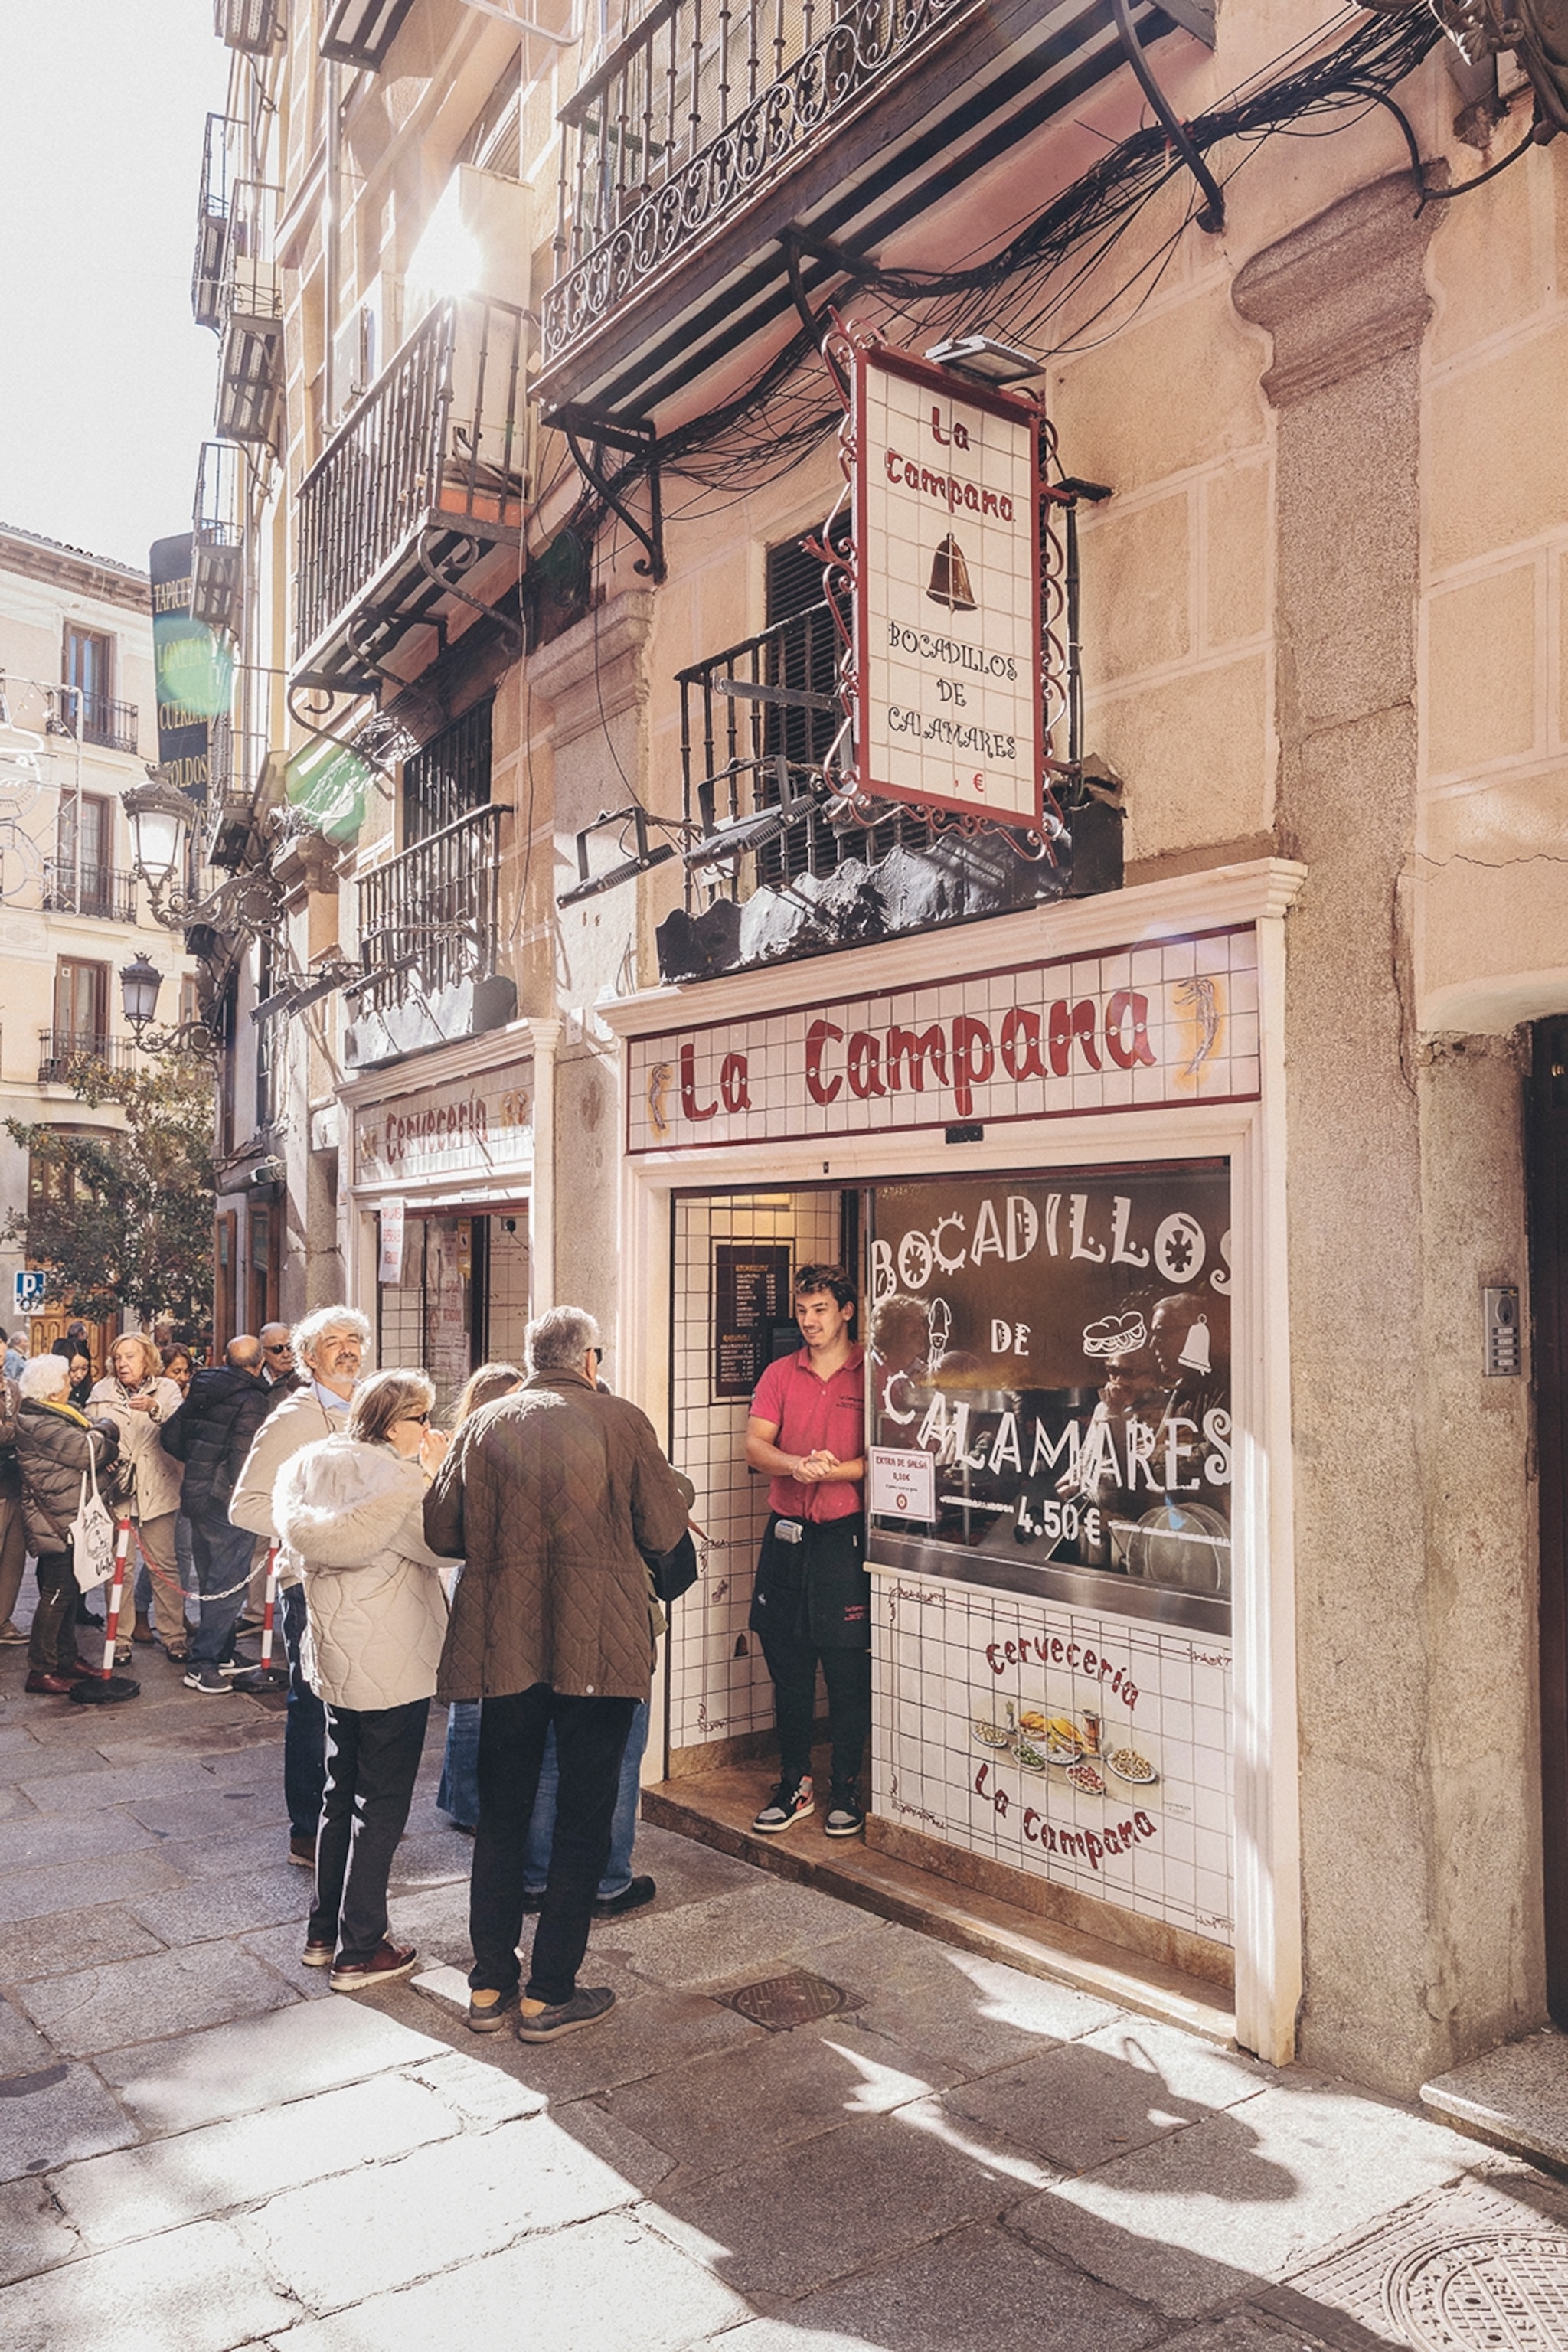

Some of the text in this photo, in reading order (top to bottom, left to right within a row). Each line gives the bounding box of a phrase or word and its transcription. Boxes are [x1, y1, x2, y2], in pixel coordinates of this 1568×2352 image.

[932, 407, 970, 452] La
[884, 447, 1017, 522] Campana
[888, 621, 1018, 681] BOCADILLOS
[936, 678, 967, 707] DE
[888, 707, 1017, 760] CALAMARES
[681, 991, 1158, 1122] La Campana
[871, 1192, 1231, 1305] BOCADILLOS
[22, 1274, 37, 1298] P
[991, 1318, 1031, 1356] DE
[881, 1370, 1232, 1492] CALAMARES
[897, 1458, 905, 1467] DE
[986, 1636, 1139, 1710] Cervecería
[975, 1762, 1157, 1870] La Campana
